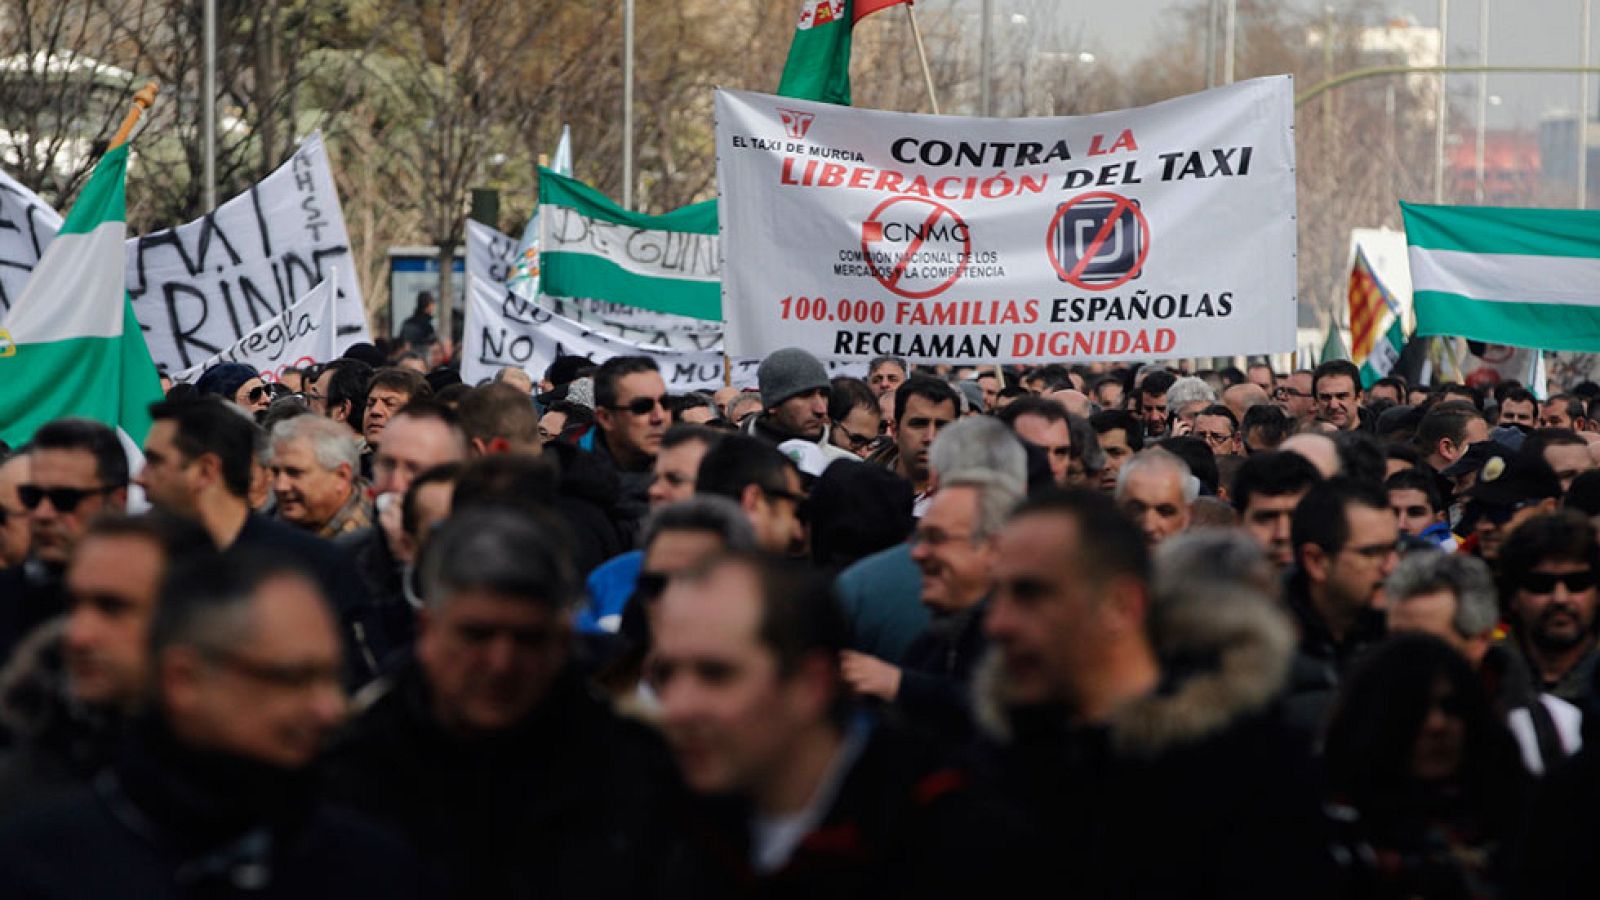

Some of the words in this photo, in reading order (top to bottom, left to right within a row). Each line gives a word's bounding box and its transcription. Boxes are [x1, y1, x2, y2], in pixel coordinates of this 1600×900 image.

[732, 135, 748, 148] EL
[750, 137, 781, 150] TAXI
[786, 143, 804, 154] DE
[809, 146, 865, 163] MURCIA
[890, 137, 1072, 167] CONTRA
[1087, 128, 1138, 157] LA
[780, 157, 1049, 200] LIBERACIÓN
[1062, 160, 1142, 190] DEL
[1158, 146, 1254, 181] TAXI
[884, 222, 969, 243] CNMC
[833, 264, 892, 278] MERCADOS
[904, 267, 919, 279] LA
[921, 265, 1005, 278] COMPETENCIA
[894, 251, 953, 265] NACIONAL
[956, 252, 972, 264] DE
[976, 251, 997, 264] LOS
[779, 295, 885, 324] 100.000
[895, 299, 1040, 326] FAMILIAS
[1050, 289, 1233, 323] ESPAÑOLAS
[479, 326, 533, 364] NO
[834, 330, 1001, 358] RECLAMAN
[1011, 328, 1177, 357] DIGNIDAD
